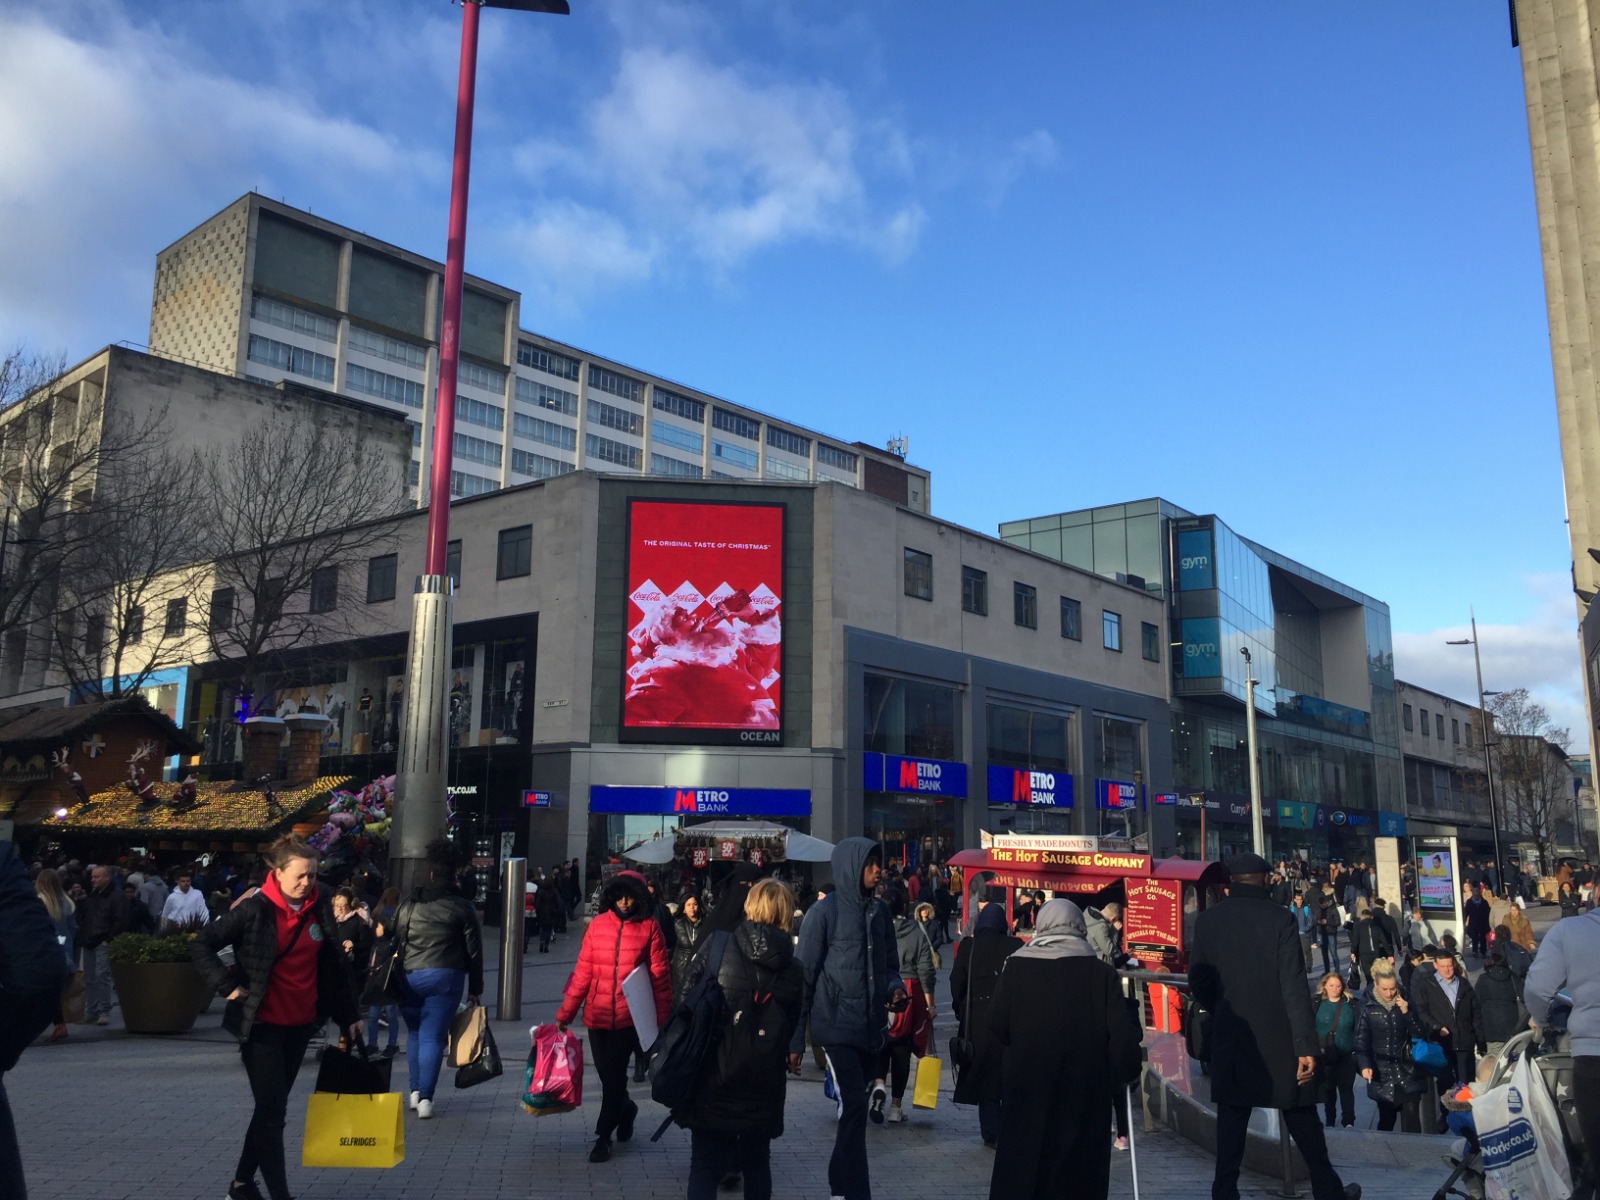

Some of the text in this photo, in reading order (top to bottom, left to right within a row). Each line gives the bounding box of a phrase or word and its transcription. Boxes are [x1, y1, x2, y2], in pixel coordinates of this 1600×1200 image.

[643, 539, 658, 547] THE
[659, 540, 692, 548] ORIGINAL
[694, 541, 716, 549] TASTE
[1181, 556, 1208, 569] gym
[1186, 643, 1216, 657] gym
[740, 731, 780, 742] OCEAN
[899, 760, 942, 790] METRO
[918, 779, 942, 792] BANK
[1012, 769, 1056, 803] METRO
[526, 793, 549, 805] METRO
[673, 789, 729, 812] METRO
[1031, 791, 1056, 805] BANK
[1108, 783, 1135, 807] METRO
[698, 803, 729, 812] BANK
[1120, 798, 1136, 808] BANK
[1230, 803, 1246, 816] Currys
[997, 838, 1034, 848] FRESHLY
[1034, 839, 1059, 848] MADE
[1058, 840, 1093, 849] DONUTS
[991, 849, 1145, 869] THE HOT SAUSAGE COMPANY
[1146, 878, 1159, 886] THE
[1128, 885, 1177, 900] HOT SAUSAGE
[1127, 929, 1149, 940] SPECIALS
[1156, 930, 1167, 939] THE
[1166, 934, 1178, 944] DAY
[339, 1137, 377, 1147] SELFRIDGES
